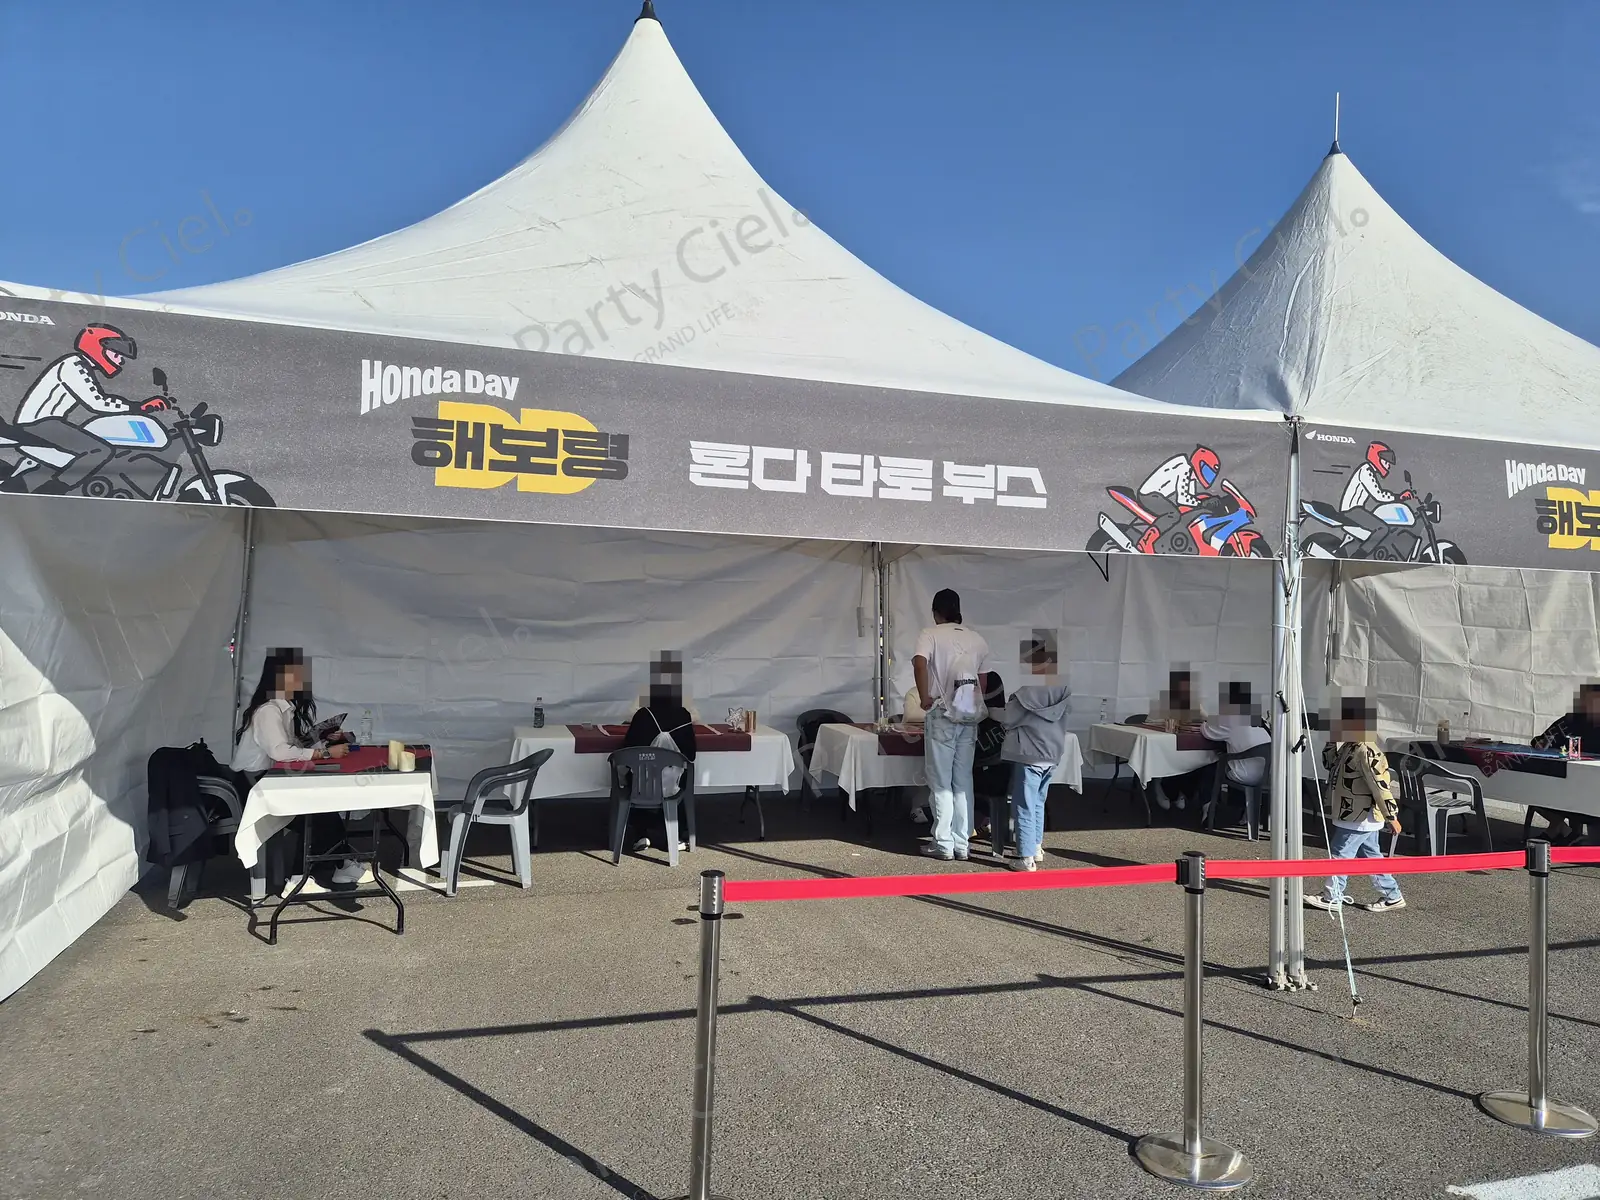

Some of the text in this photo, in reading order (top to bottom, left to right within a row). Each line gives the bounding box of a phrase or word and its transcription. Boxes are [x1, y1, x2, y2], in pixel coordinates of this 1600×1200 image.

[1316, 433, 1356, 444] HONDA
[689, 440, 1048, 509] 혼다 타로 부스
